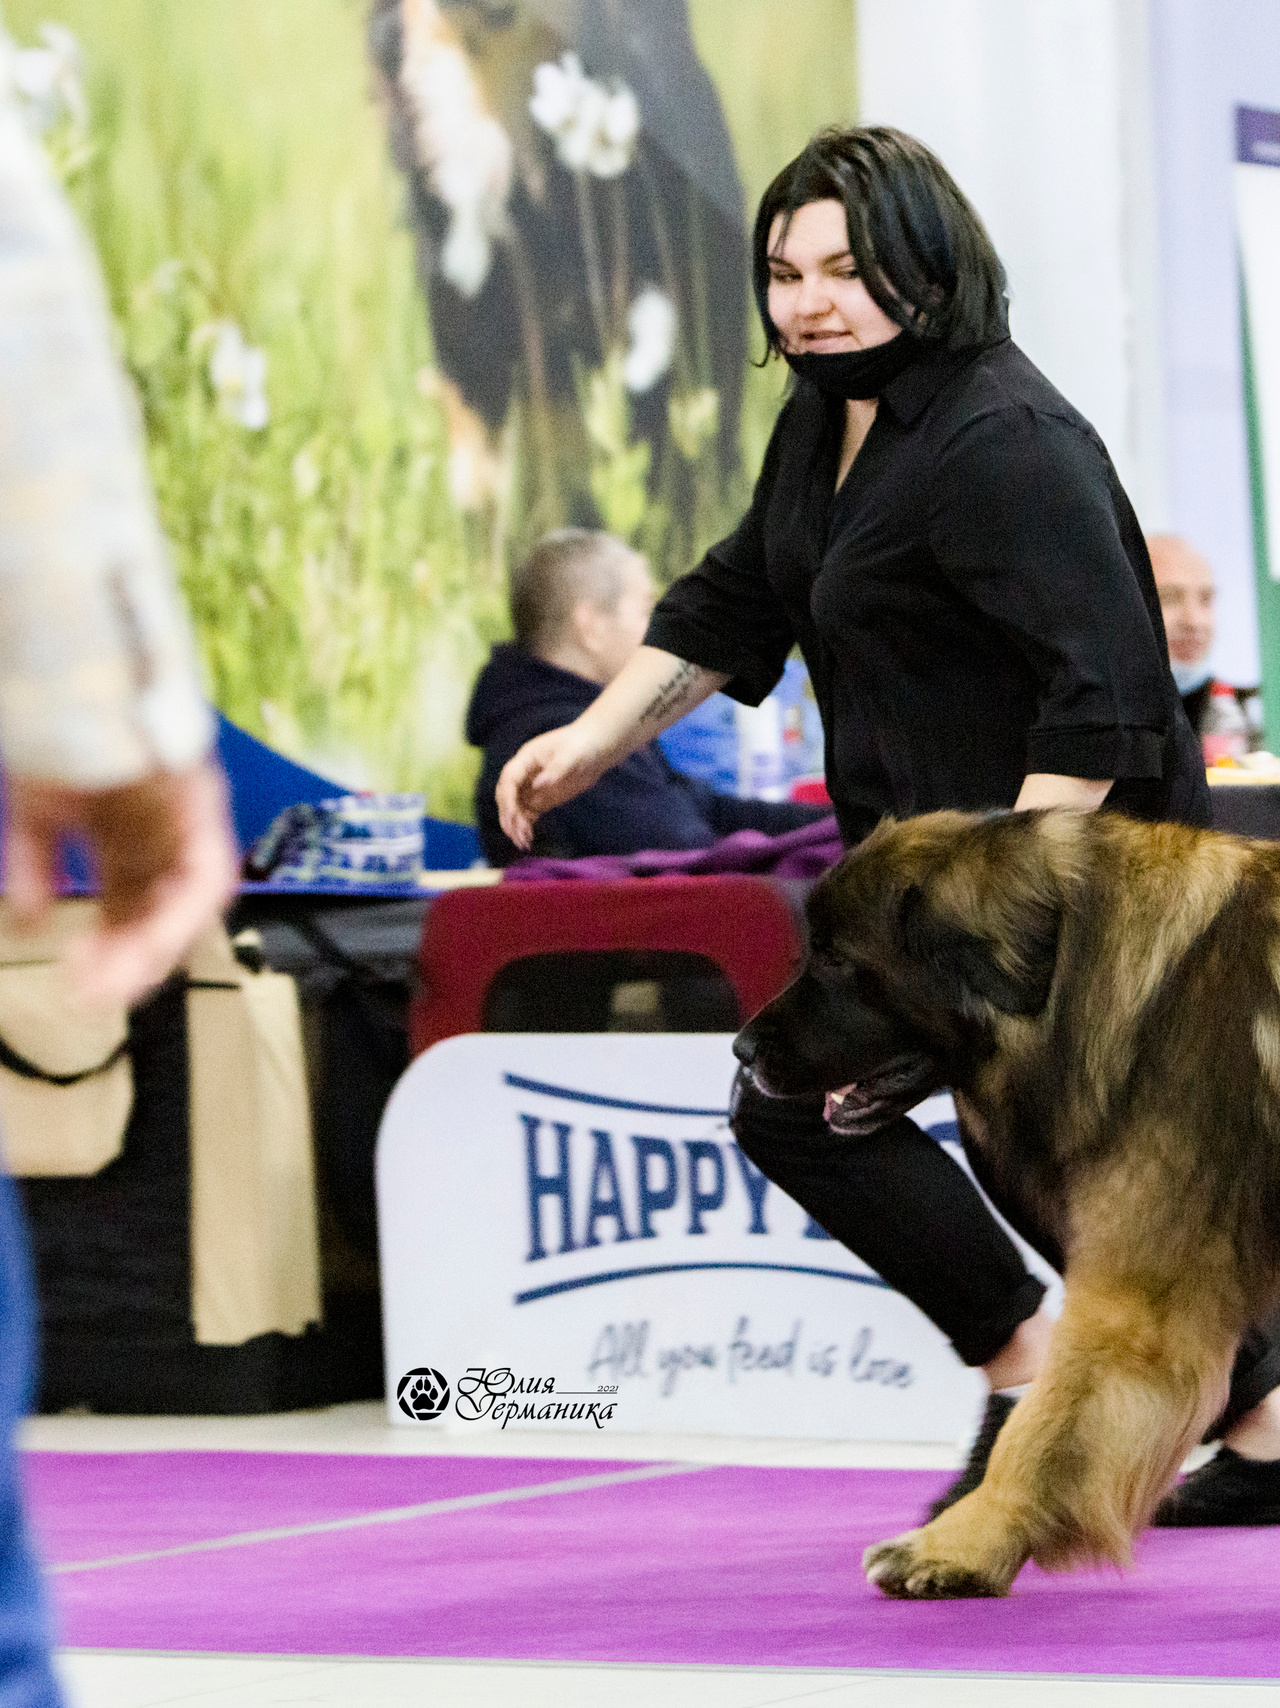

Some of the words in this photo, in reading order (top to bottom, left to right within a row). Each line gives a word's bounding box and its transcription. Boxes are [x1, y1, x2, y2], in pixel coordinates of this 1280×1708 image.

[518, 1112, 772, 1264] HAPPY
[585, 1318, 649, 1383] All
[657, 1343, 717, 1399] you
